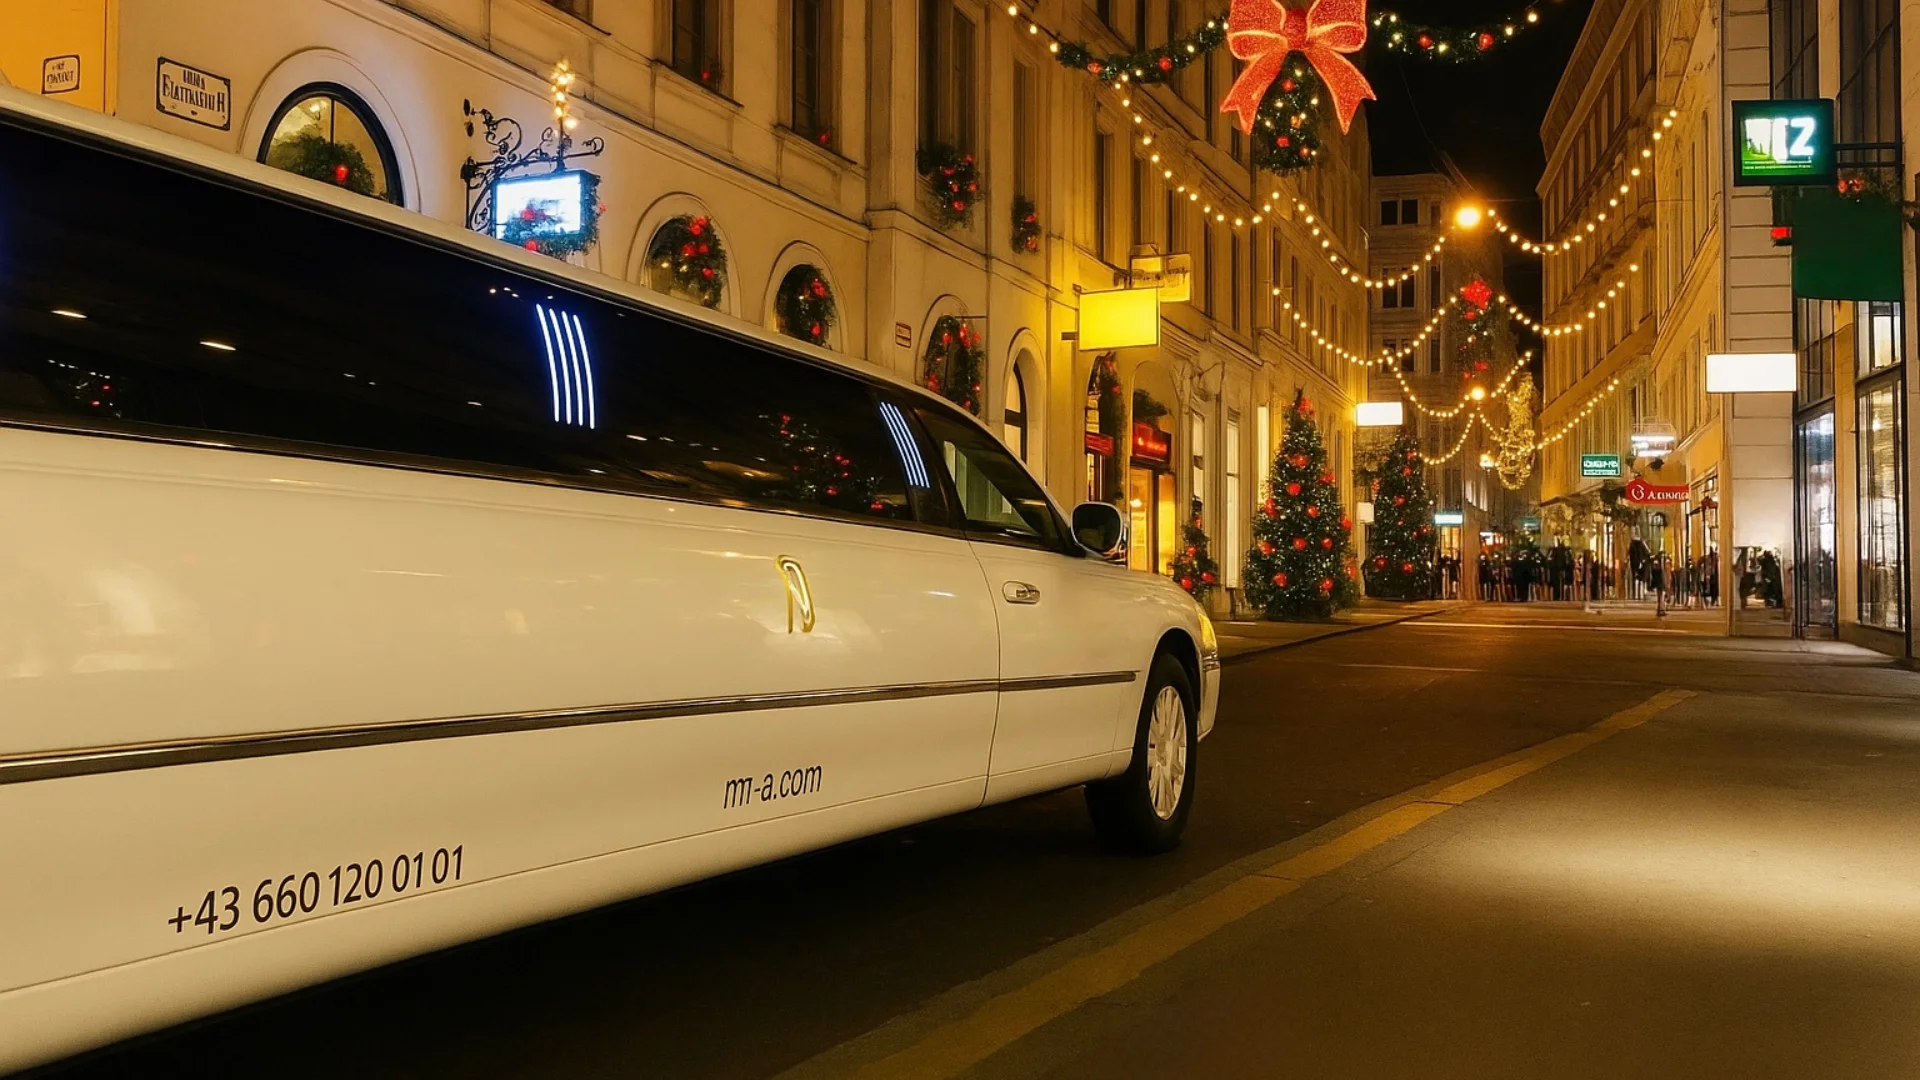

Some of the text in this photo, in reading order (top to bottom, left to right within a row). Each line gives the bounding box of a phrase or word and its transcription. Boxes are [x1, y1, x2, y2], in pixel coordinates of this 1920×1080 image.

[167, 885, 241, 935] +43
[252, 871, 321, 924] 660
[328, 858, 384, 907] 120
